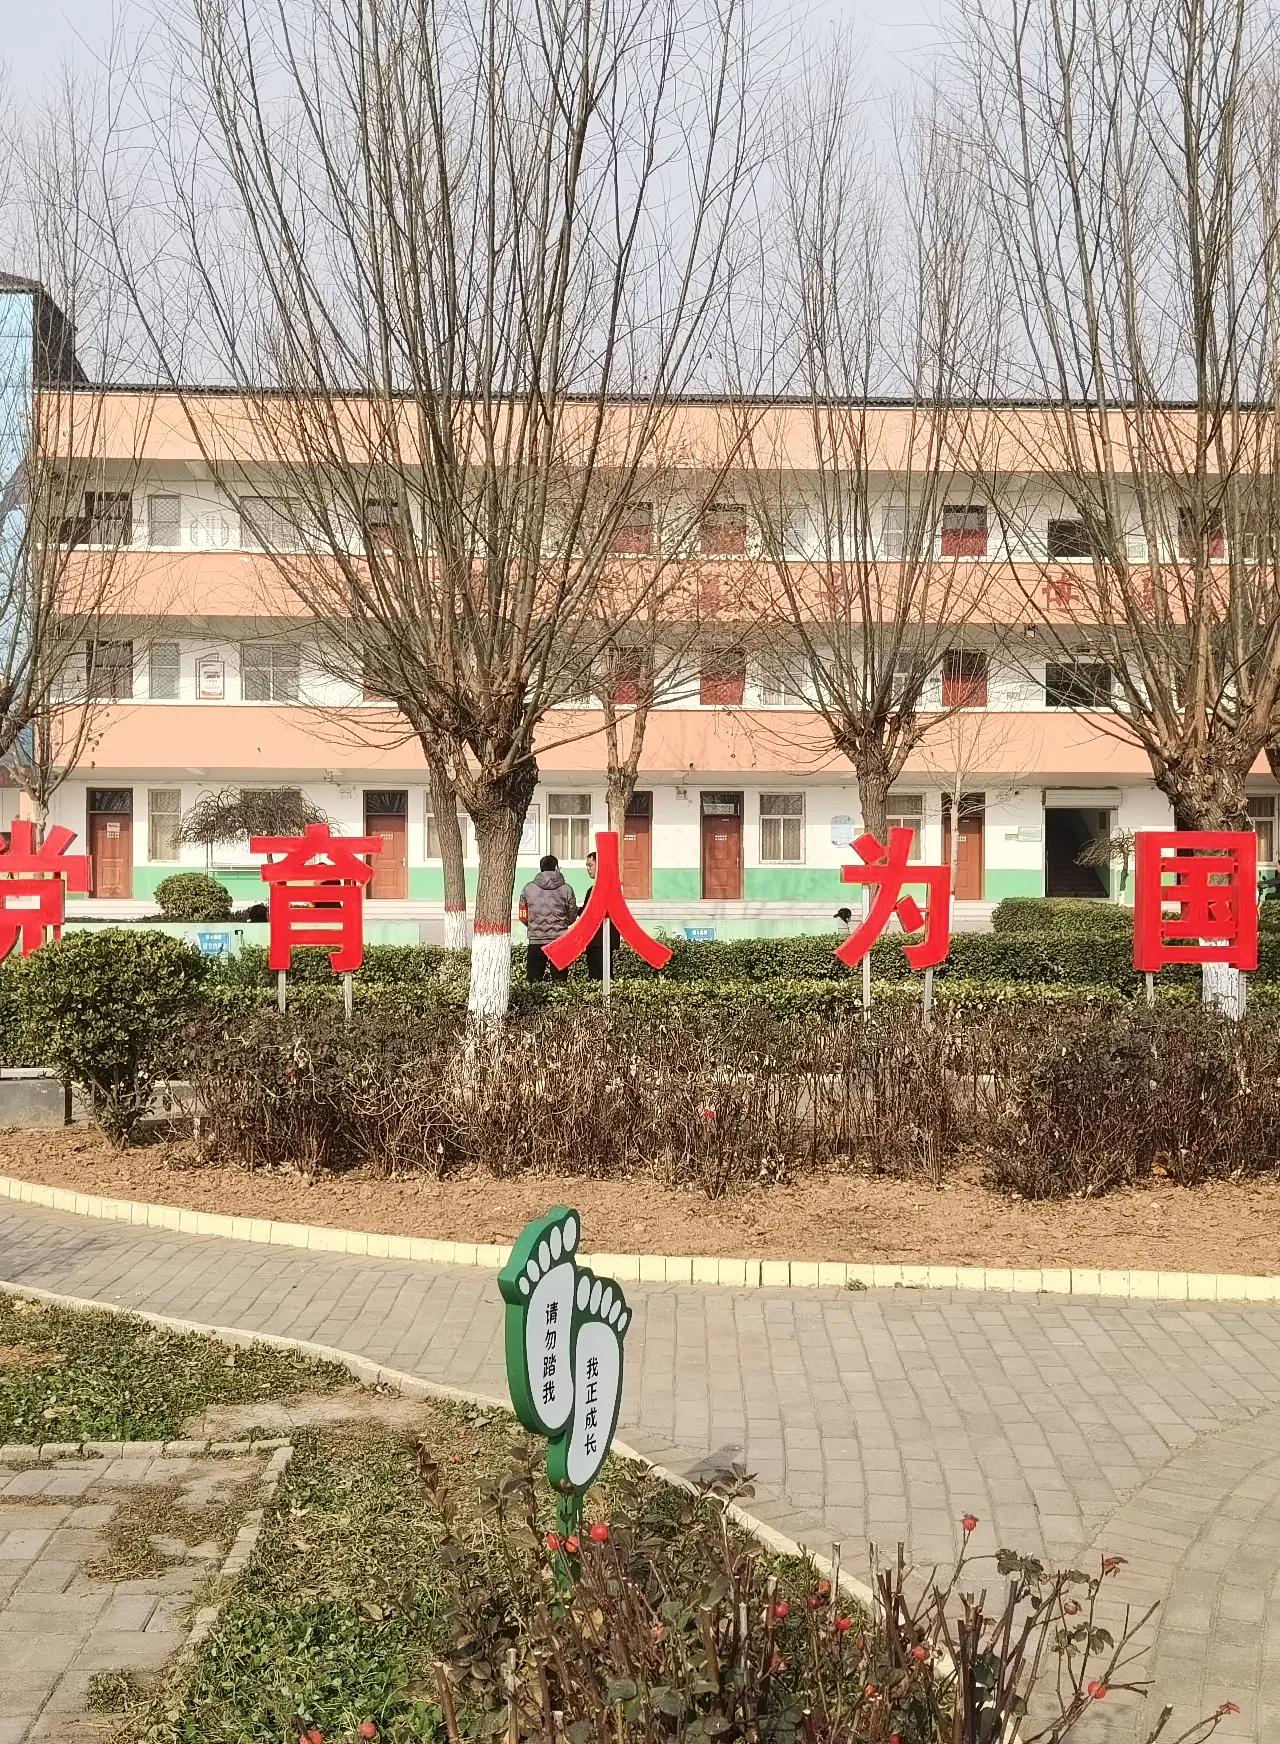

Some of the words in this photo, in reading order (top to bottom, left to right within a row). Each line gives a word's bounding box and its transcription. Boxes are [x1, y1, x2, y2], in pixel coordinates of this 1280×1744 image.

[542, 1301, 559, 1404] 请勿踏我
[583, 1357, 599, 1456] 我正成长
